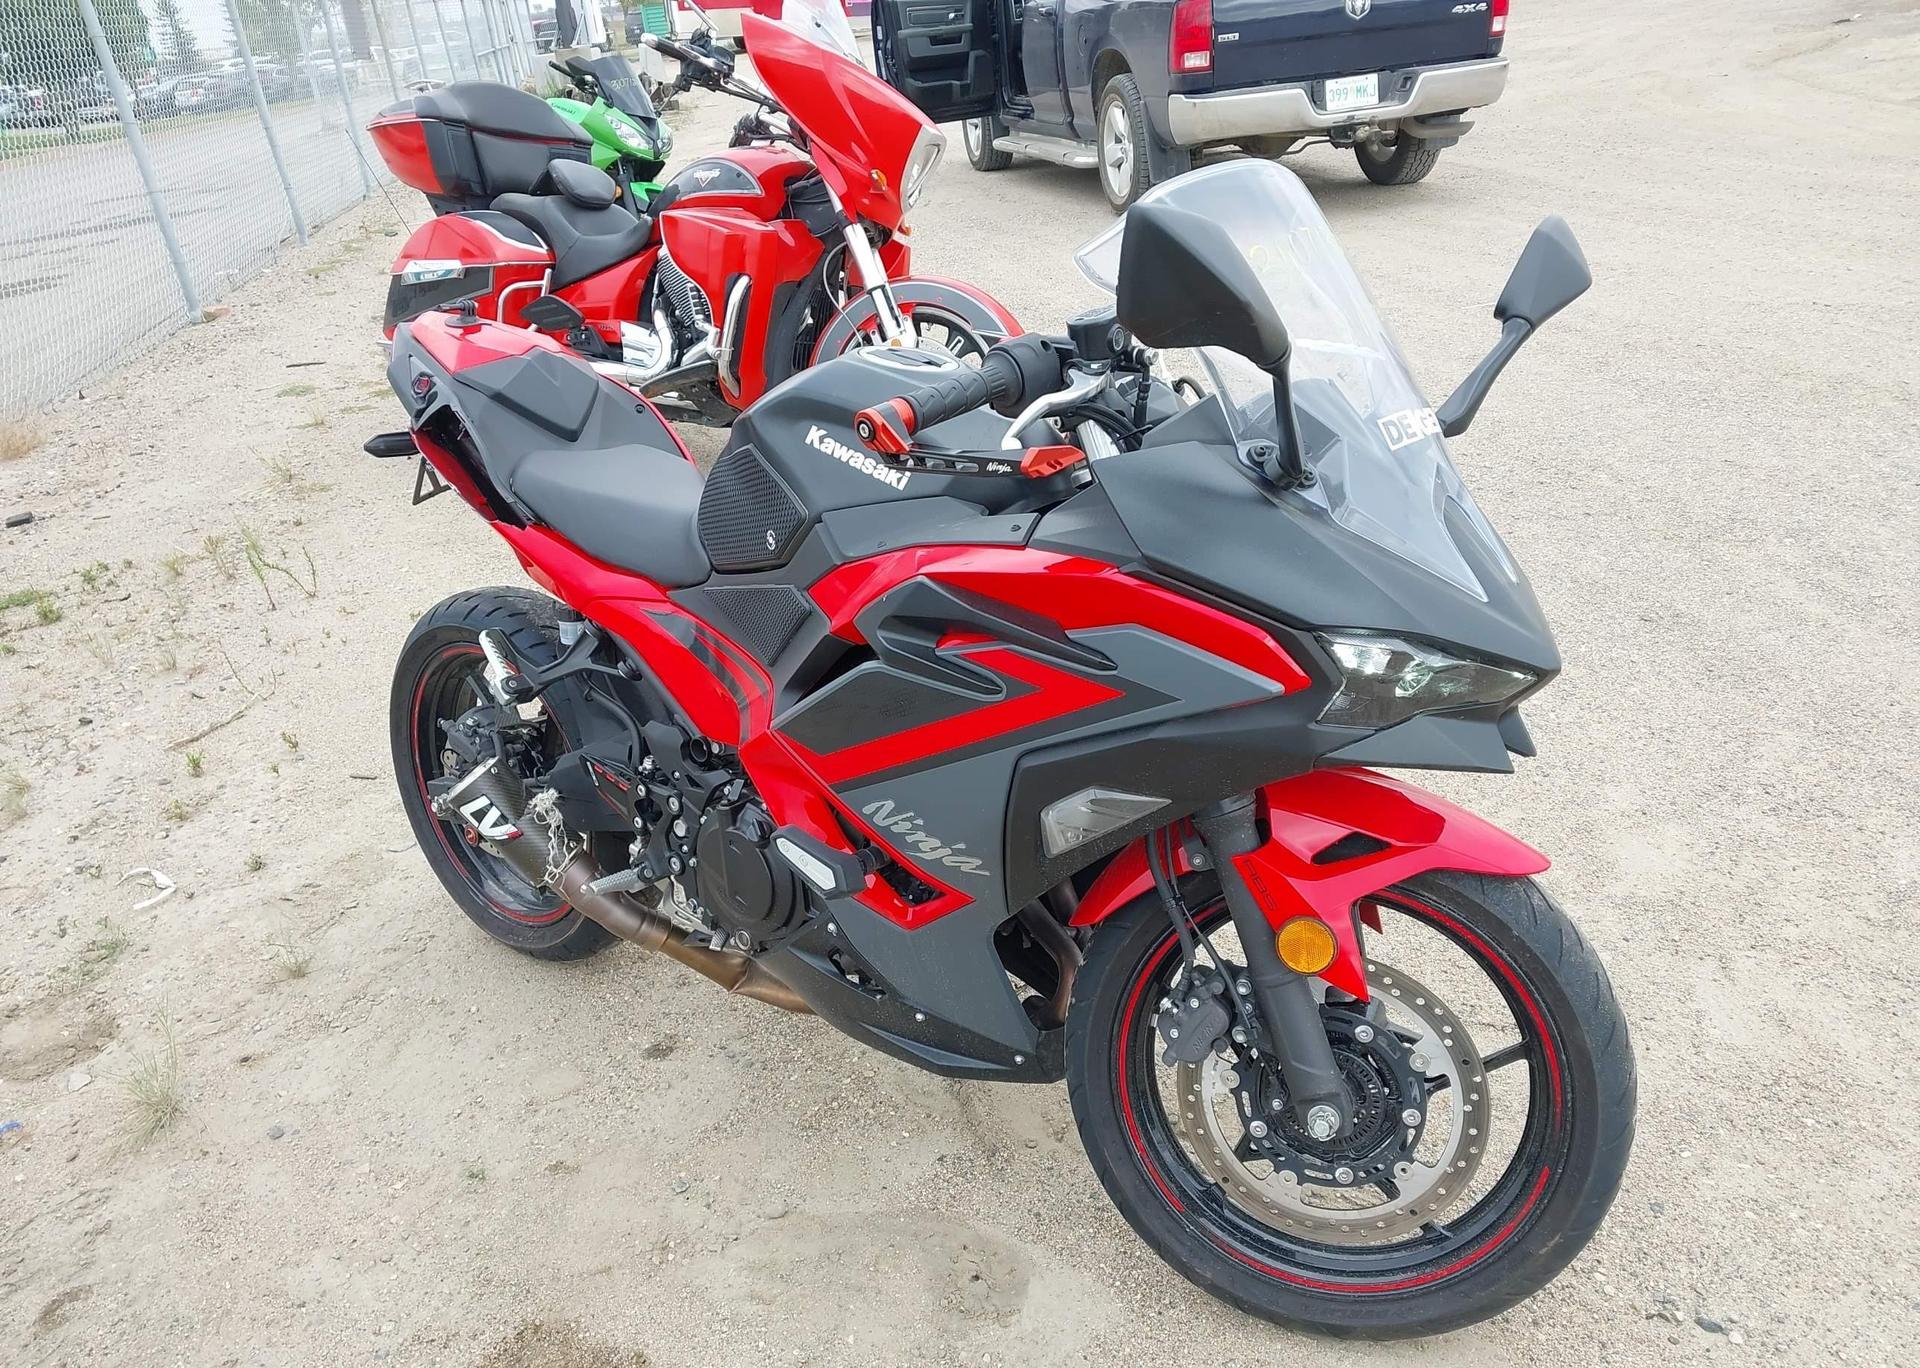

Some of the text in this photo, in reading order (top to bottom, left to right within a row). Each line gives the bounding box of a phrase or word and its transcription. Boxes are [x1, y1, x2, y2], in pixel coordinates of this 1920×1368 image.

[1329, 83, 1376, 102] 399 MKJ
[804, 425, 912, 491] Kawasaki
[986, 461, 1013, 475] Ninja
[862, 800, 990, 876] Ninja
[1242, 859, 1278, 911] ABS
